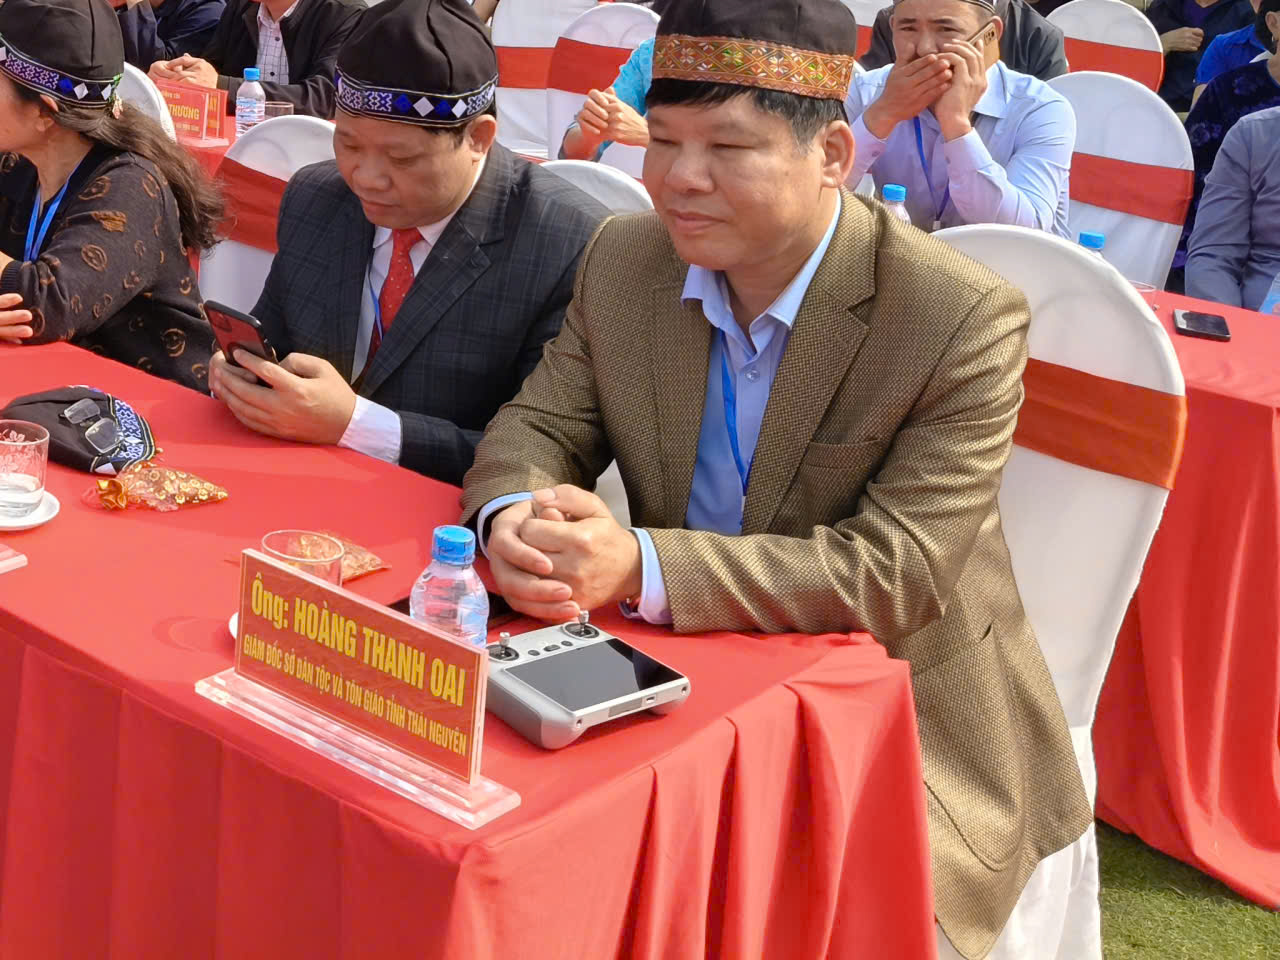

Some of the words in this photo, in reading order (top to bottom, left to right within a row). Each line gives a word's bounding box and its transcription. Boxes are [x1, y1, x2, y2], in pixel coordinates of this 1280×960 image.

[243, 633, 265, 662] GIÁM
[266, 640, 282, 669] ĐỐC
[283, 648, 296, 675] SỞ
[296, 655, 313, 683] DÂN
[315, 663, 331, 693] TỘC
[332, 672, 344, 700] VÀ
[345, 679, 362, 708] TÔN
[363, 688, 384, 718] GIÁO
[386, 694, 405, 729] TỈNH
[407, 709, 428, 739] THÁI
[428, 719, 467, 757] NGUYÊN
[251, 571, 289, 630] Ông:
[294, 597, 357, 658] HOÀNG
[362, 626, 426, 690] THANH
[430, 657, 466, 707] OAI
